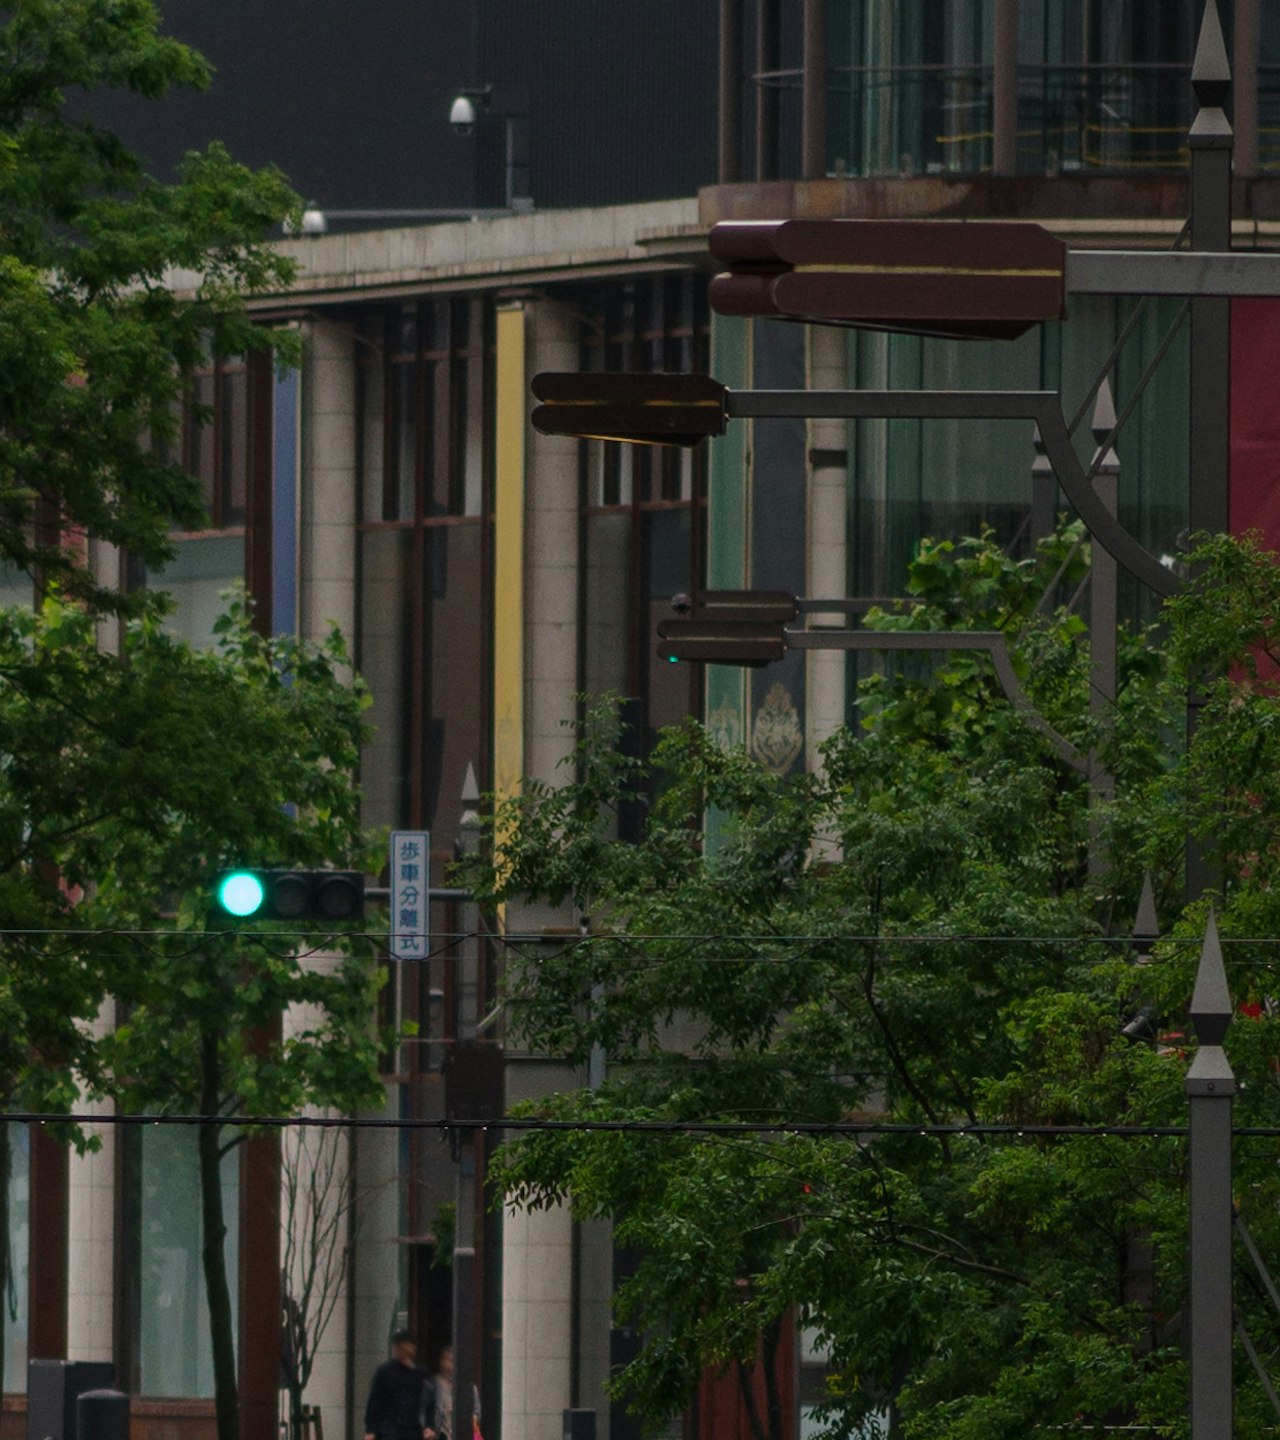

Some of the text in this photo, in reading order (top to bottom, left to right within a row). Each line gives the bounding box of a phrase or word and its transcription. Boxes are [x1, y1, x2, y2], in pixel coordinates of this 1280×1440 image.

[400, 842, 420, 951] 歩車分離式
